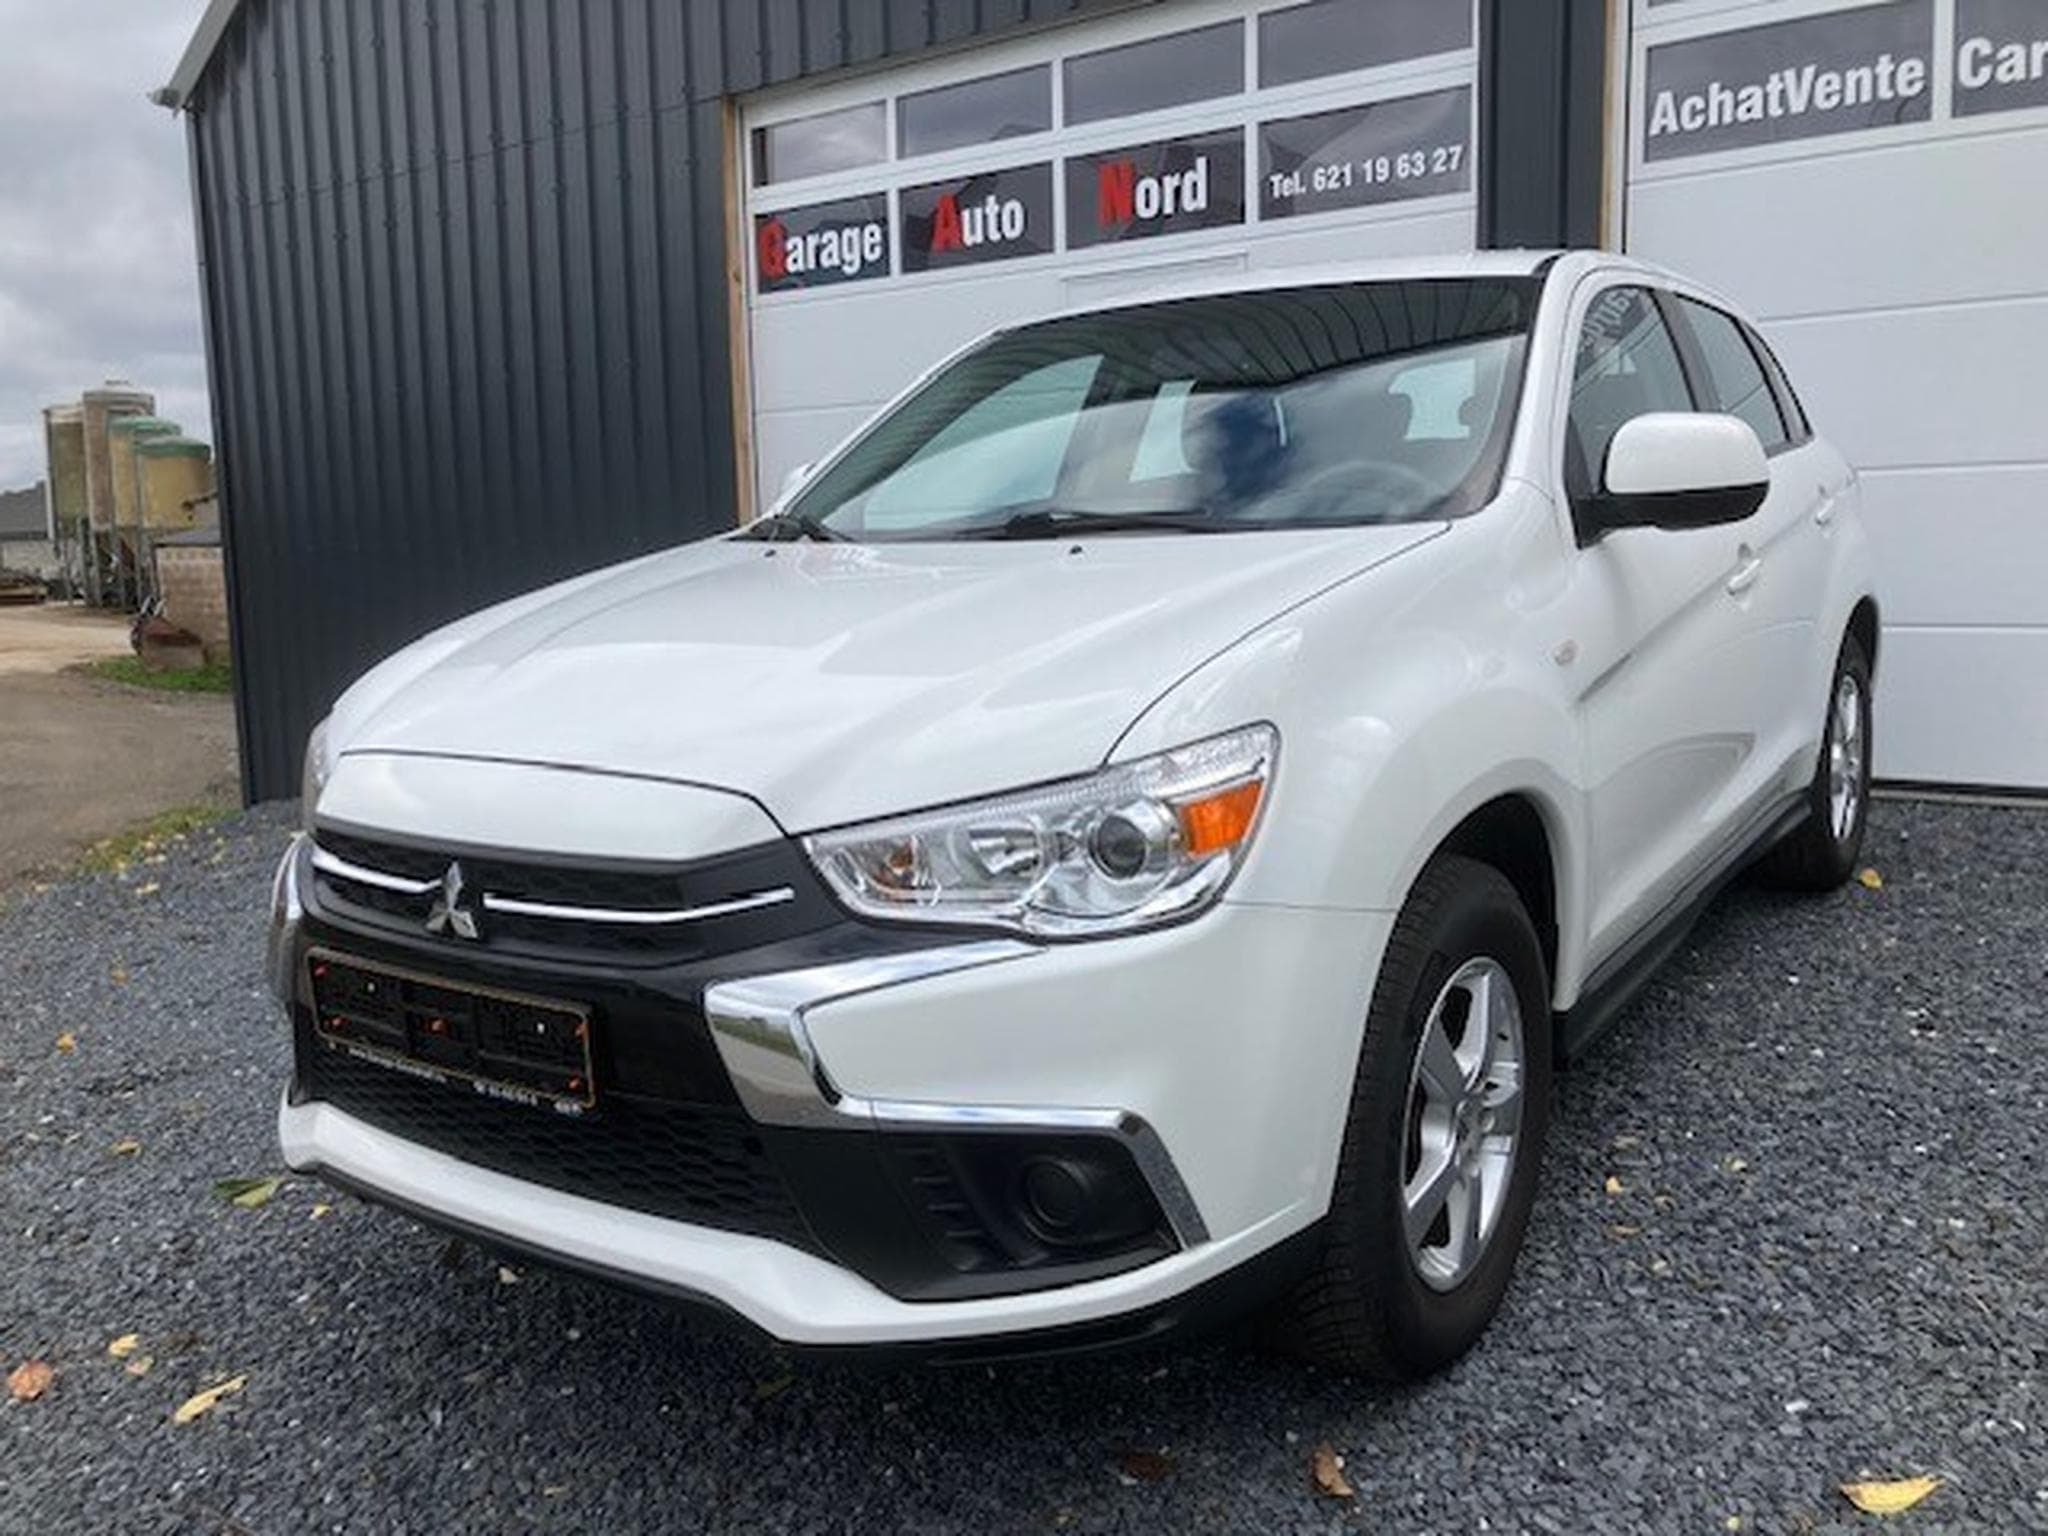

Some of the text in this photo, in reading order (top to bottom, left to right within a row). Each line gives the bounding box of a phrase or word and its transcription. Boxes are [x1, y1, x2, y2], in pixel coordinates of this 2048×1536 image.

[1270, 145, 1463, 198] Tel. 621 19 63 27
[759, 157, 1208, 275] Garage Auto Nord
